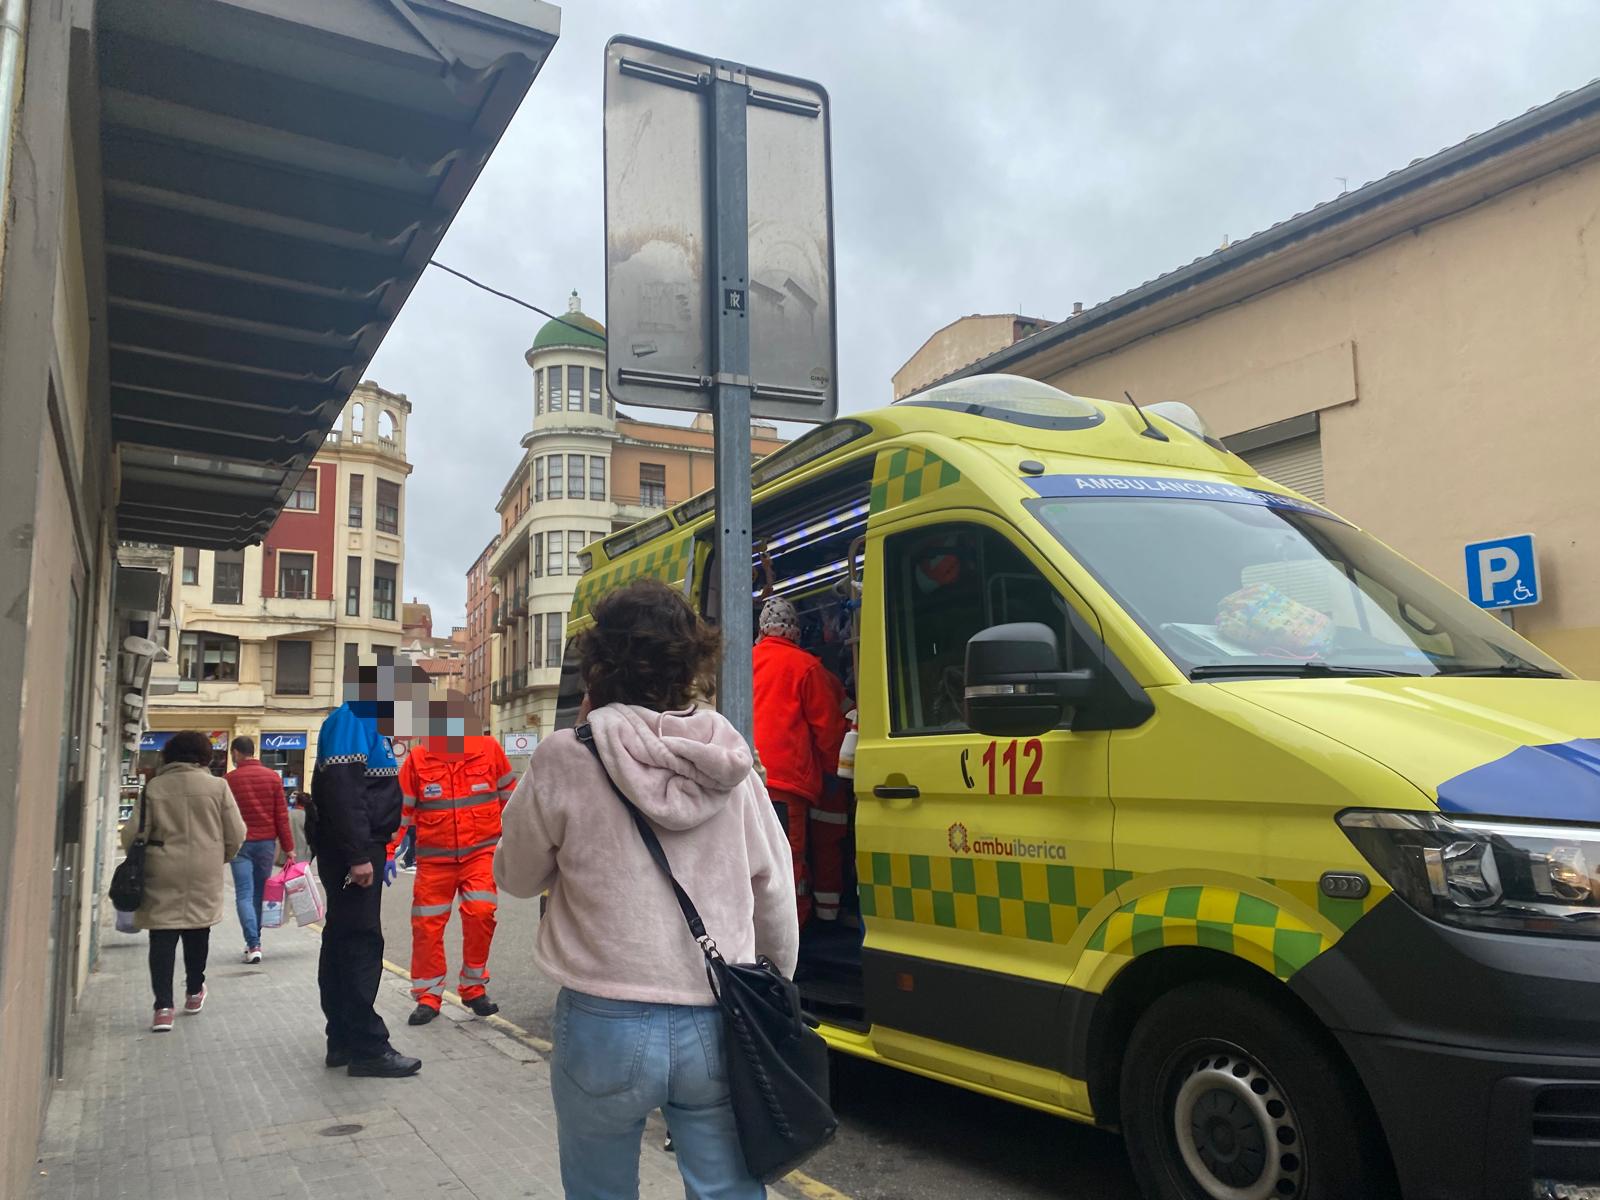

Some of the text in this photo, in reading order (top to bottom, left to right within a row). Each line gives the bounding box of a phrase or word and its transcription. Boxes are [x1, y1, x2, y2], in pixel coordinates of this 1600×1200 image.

[1074, 476, 1226, 497] AMBULANCIA
[1478, 546, 1520, 602] P
[982, 738, 1044, 796] 112
[973, 837, 1067, 860] ambuiberica
